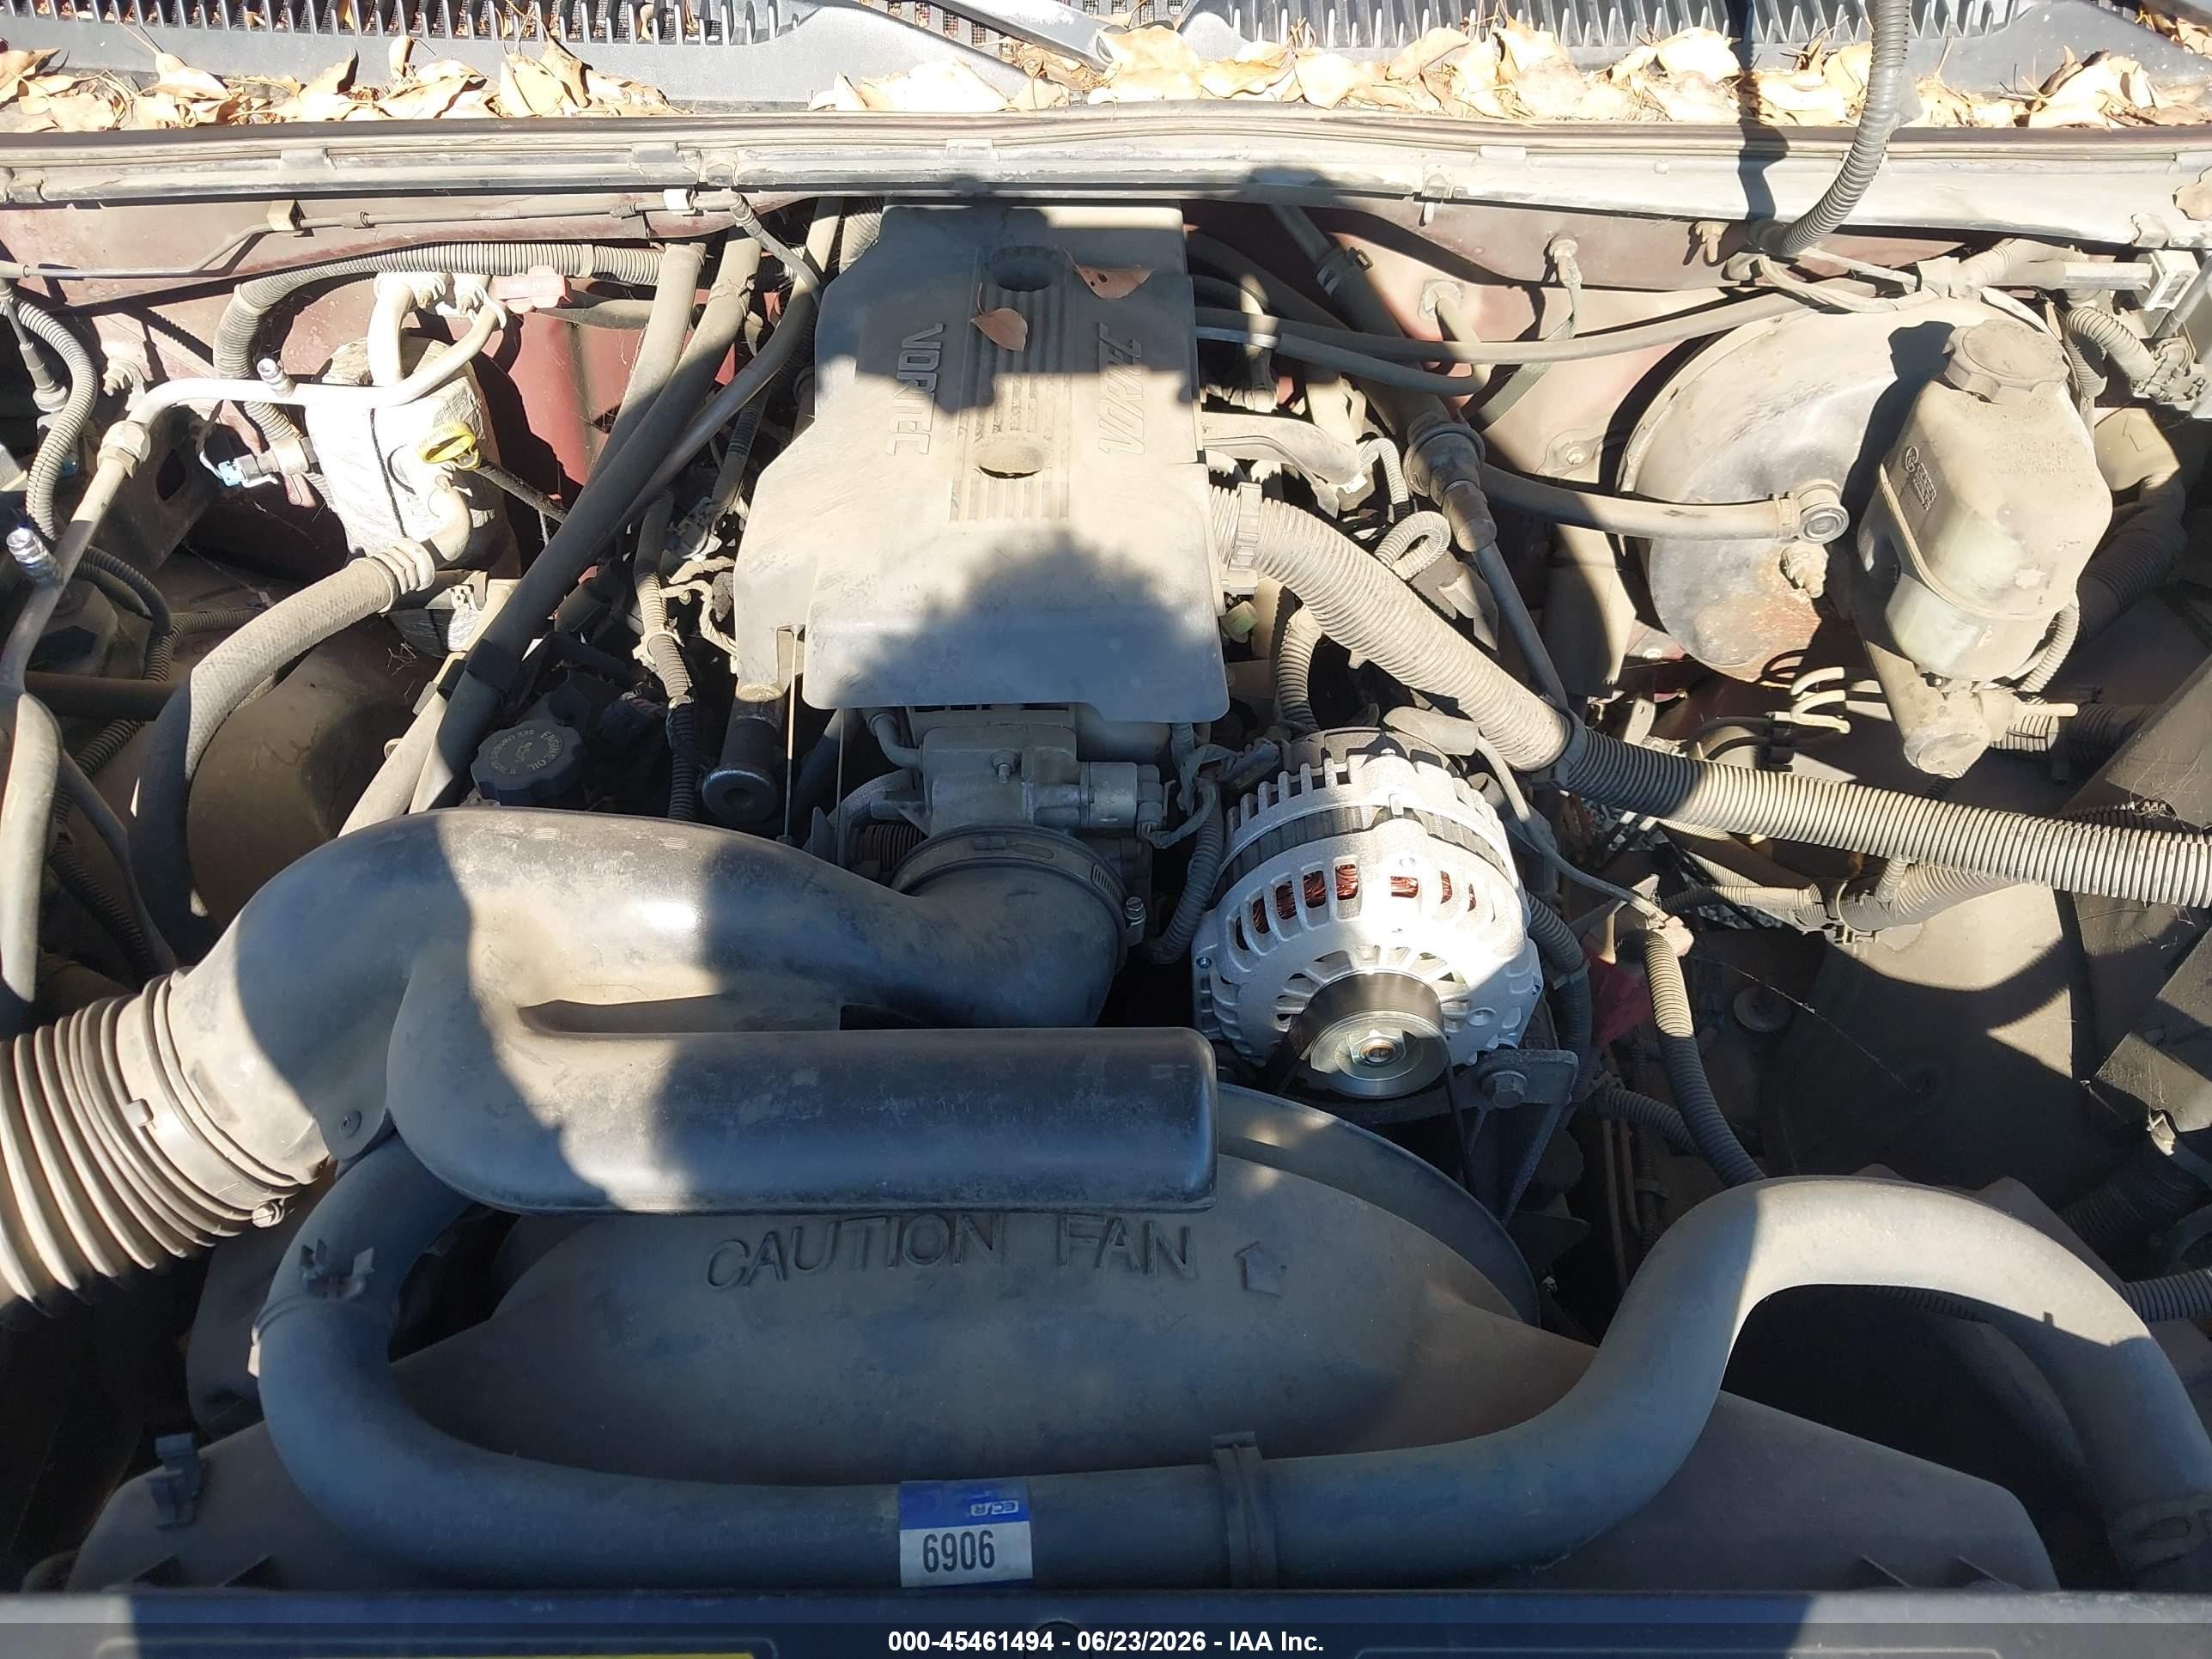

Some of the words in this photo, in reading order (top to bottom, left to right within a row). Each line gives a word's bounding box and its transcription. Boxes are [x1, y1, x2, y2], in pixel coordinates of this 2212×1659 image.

[886, 322, 945, 456] VORTEC
[527, 759, 547, 770] OIL
[707, 1213, 1004, 1288] CAUTION
[1059, 1212, 1199, 1280] FAN
